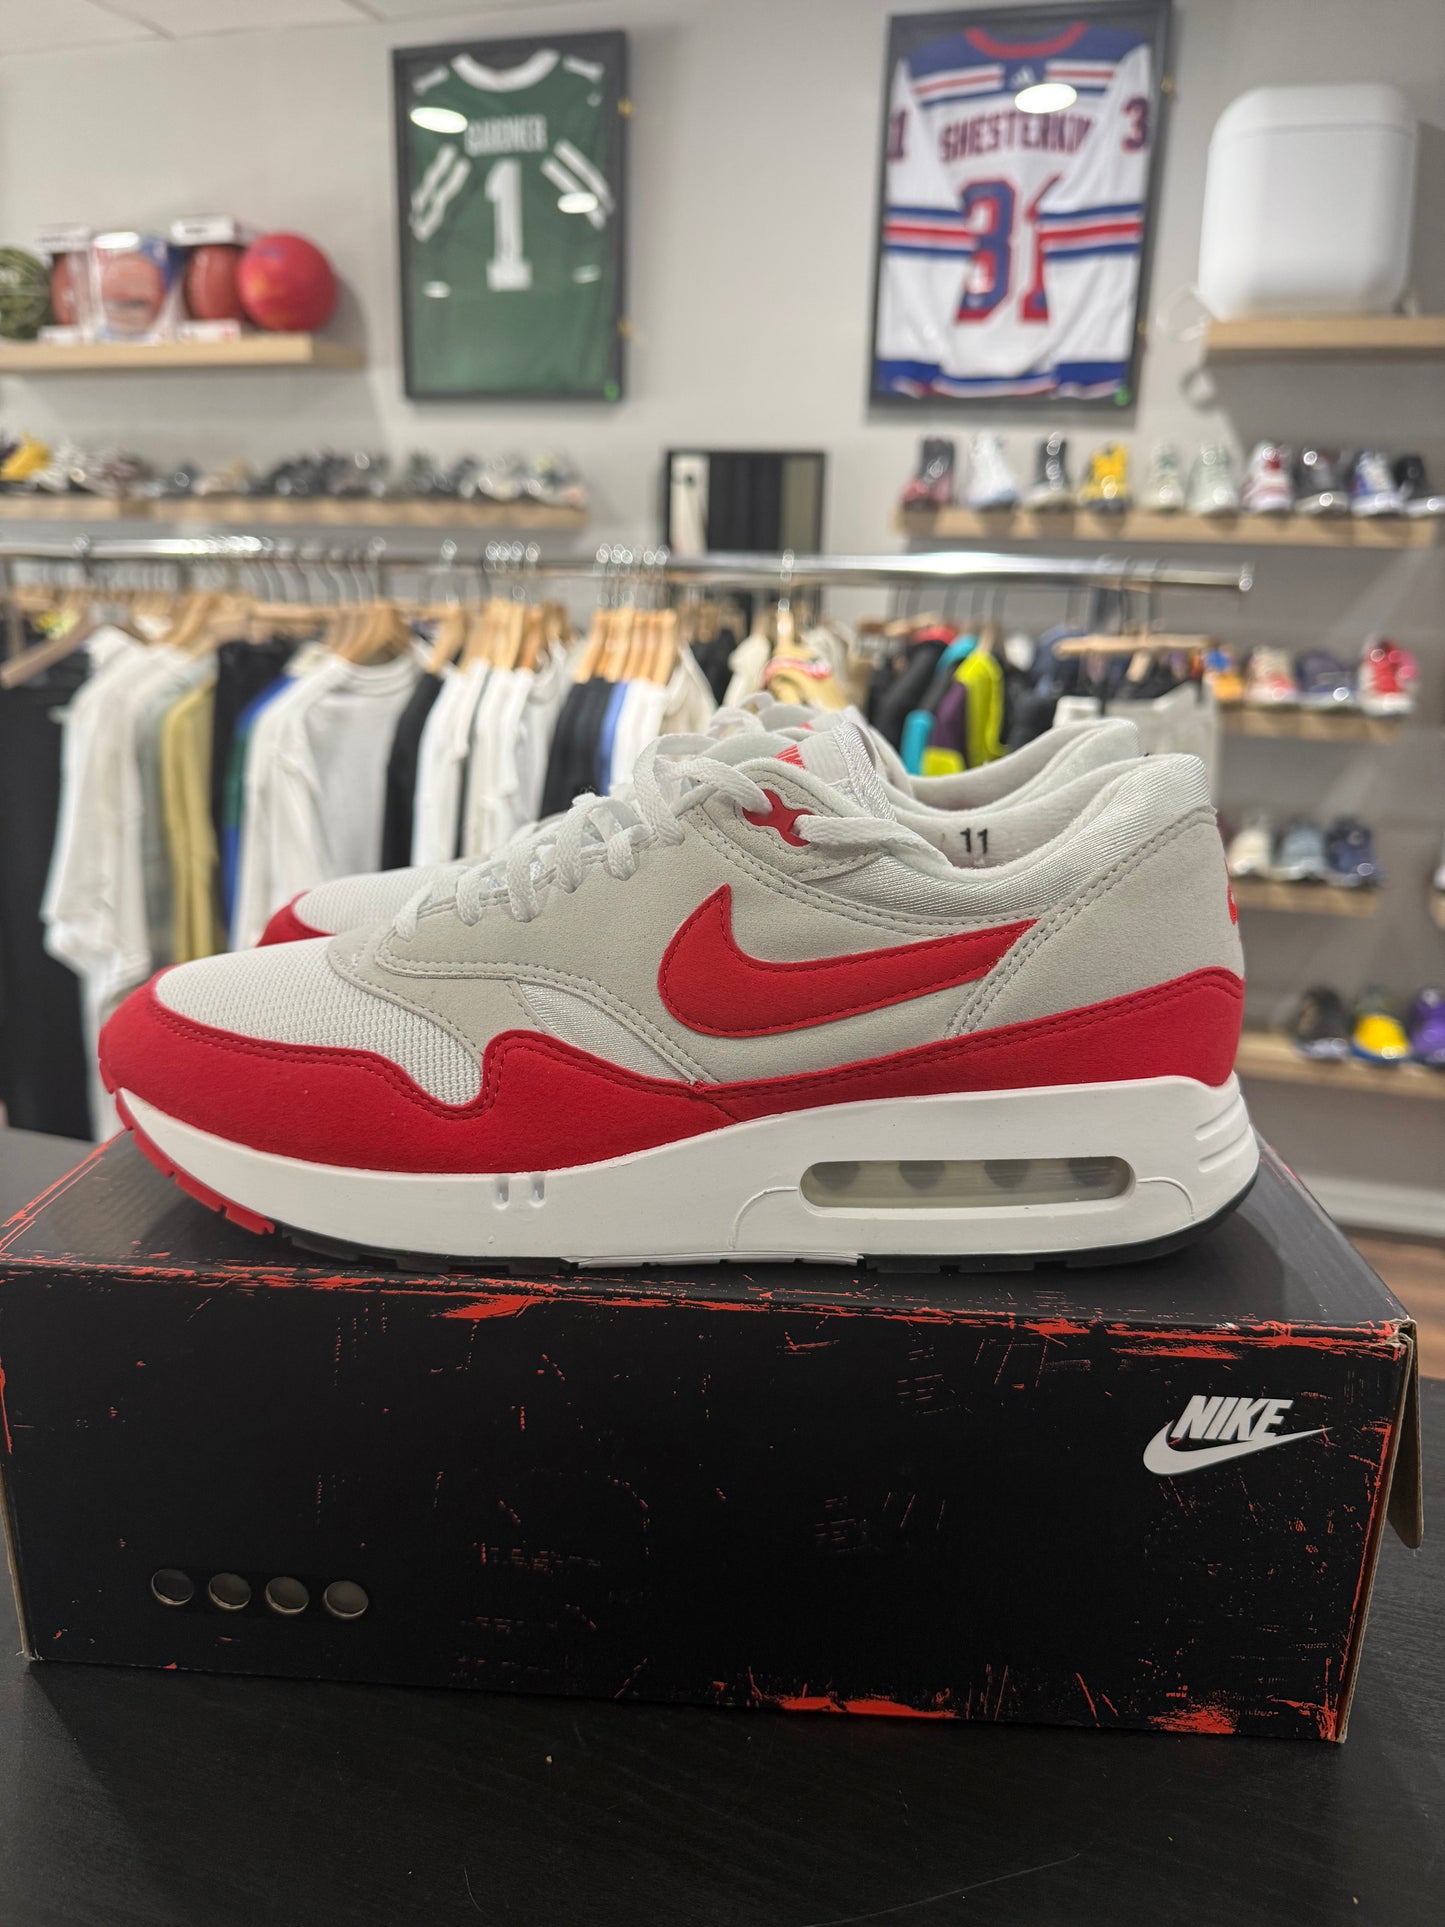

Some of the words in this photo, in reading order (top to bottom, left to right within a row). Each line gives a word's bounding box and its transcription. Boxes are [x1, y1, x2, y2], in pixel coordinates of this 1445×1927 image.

[485, 158, 533, 292] 1
[960, 828, 988, 854] 11
[1170, 1395, 1294, 1441] NIKE
